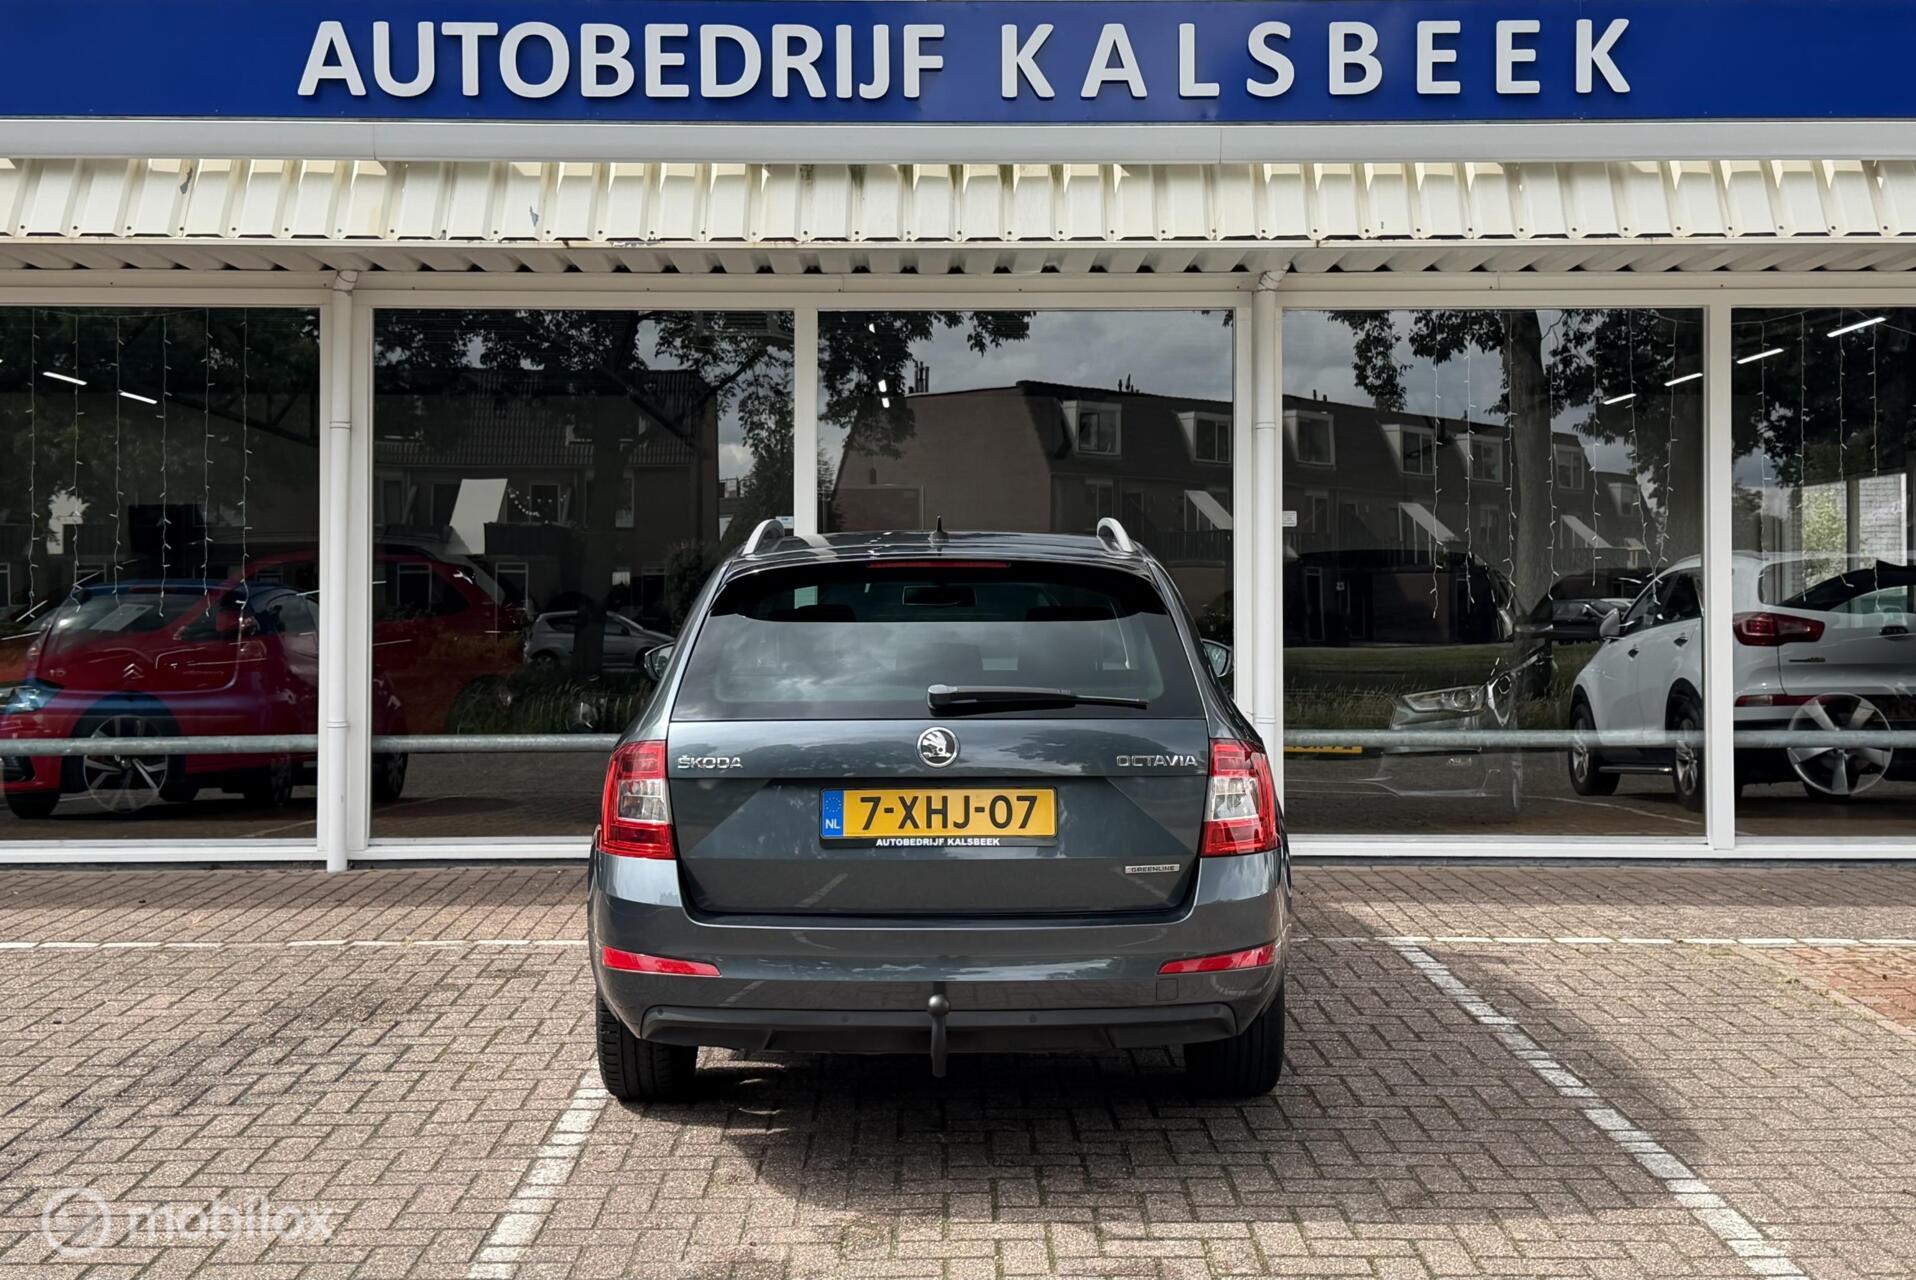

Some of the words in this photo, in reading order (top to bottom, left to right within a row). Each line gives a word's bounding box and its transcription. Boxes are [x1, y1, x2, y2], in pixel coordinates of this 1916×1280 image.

[297, 20, 945, 99] AUTOBEDRIJF
[1001, 18, 1631, 99] KALSBEEK
[677, 754, 744, 769] ŠKODA
[1116, 754, 1198, 767] OCTAVIA
[859, 794, 1038, 831] 7-XHJ-07
[825, 819, 841, 829] NL
[876, 837, 945, 846] AUTOBEDRIJF
[947, 837, 1001, 846] KALSBEEK
